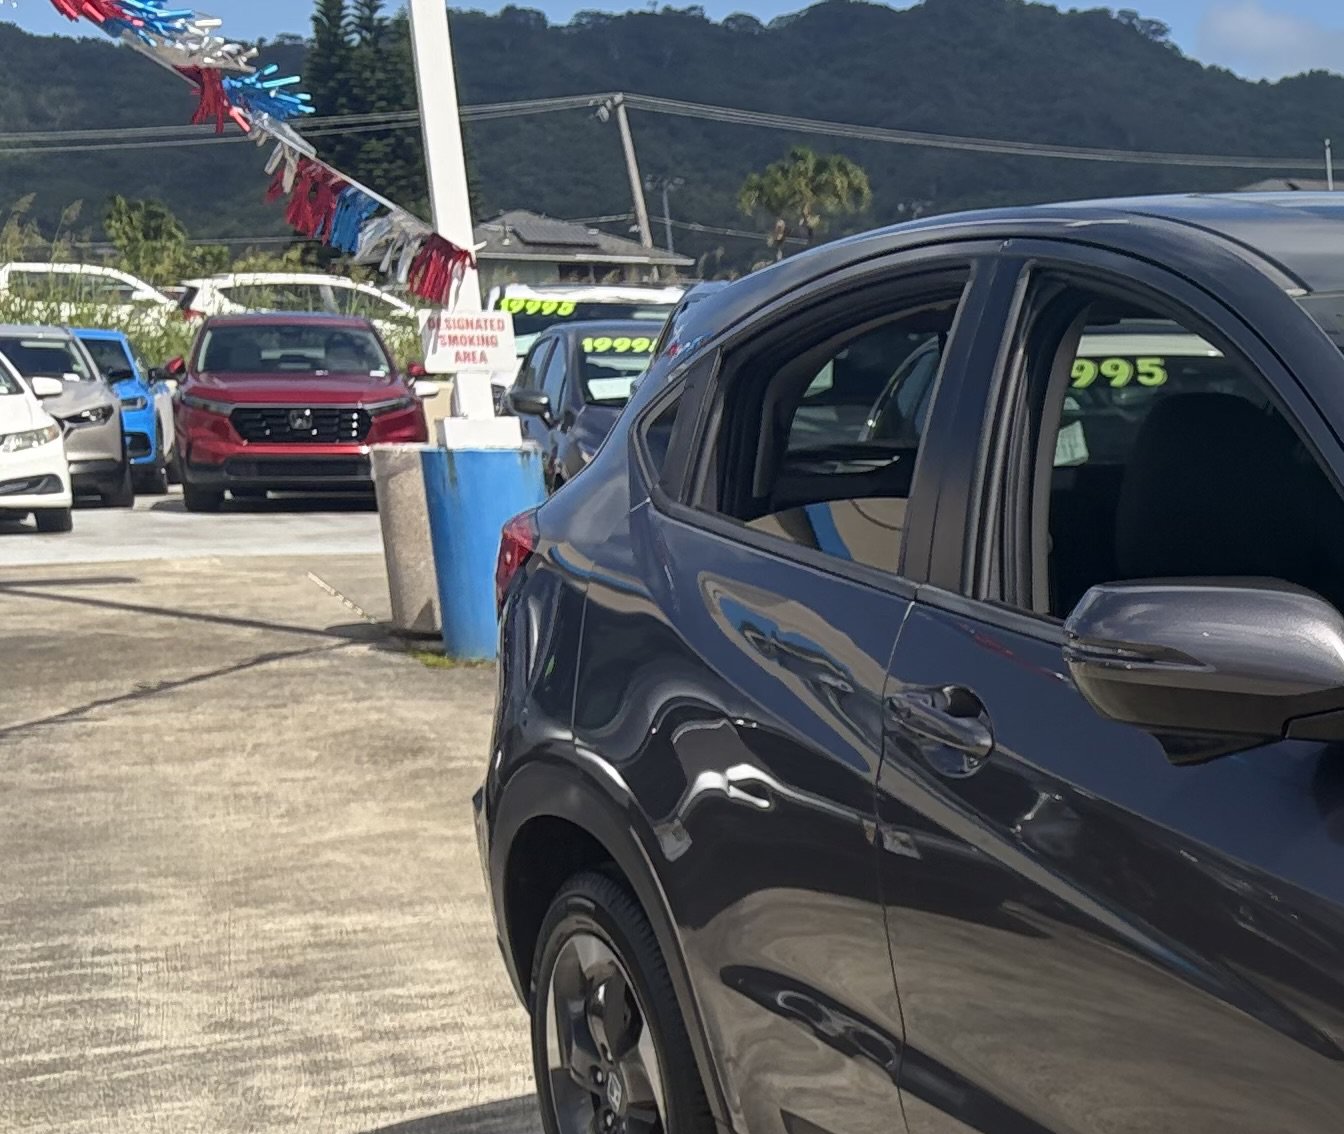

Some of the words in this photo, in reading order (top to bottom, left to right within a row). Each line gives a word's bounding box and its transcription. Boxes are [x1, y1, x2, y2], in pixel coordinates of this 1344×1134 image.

[427, 318, 505, 331] DESIGNATED
[439, 334, 498, 347] SMOKING
[455, 350, 488, 364] AREA
